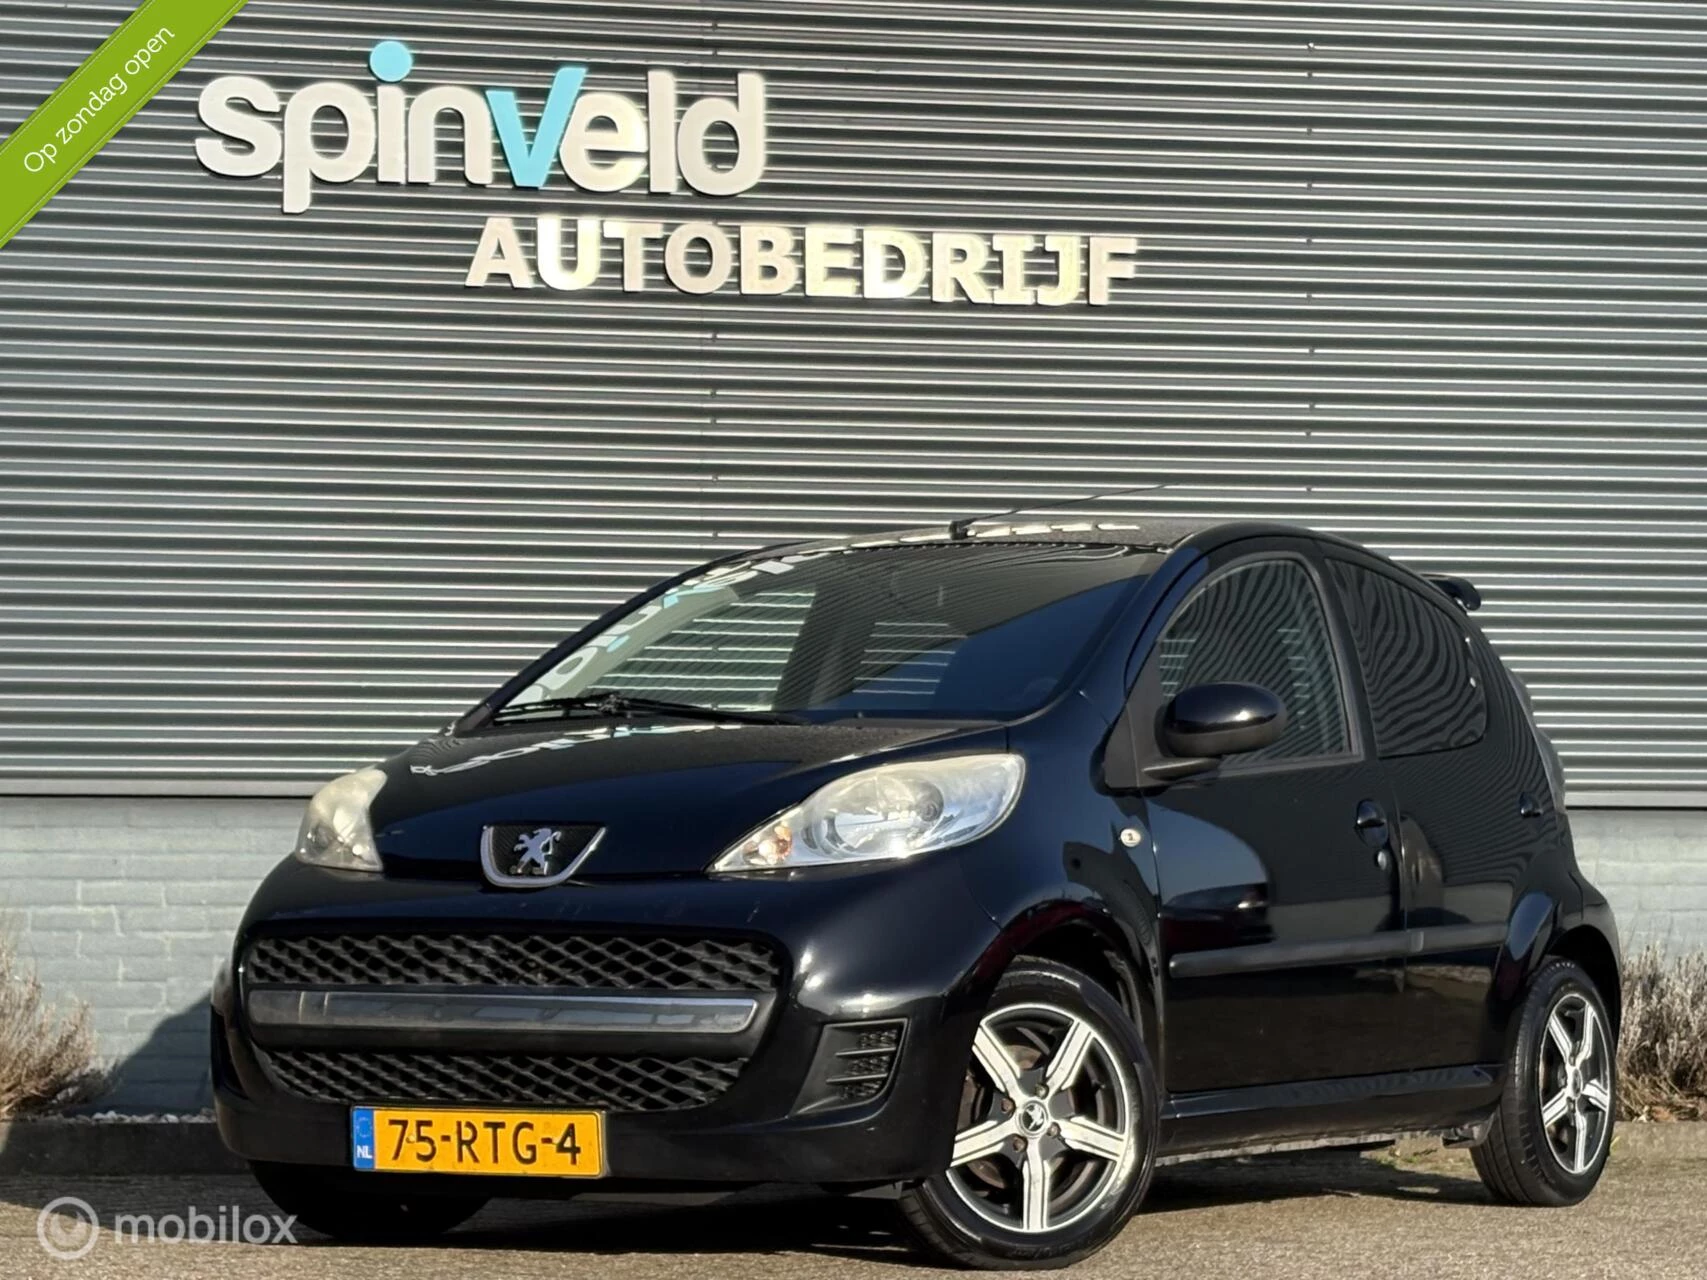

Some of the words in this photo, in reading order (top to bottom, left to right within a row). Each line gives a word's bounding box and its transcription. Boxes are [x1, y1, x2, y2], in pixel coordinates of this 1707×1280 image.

[465, 215, 1139, 306] AUTOBEDRIJF
[356, 1145, 373, 1159] NL
[388, 1118, 582, 1166] 75-RTG-4
